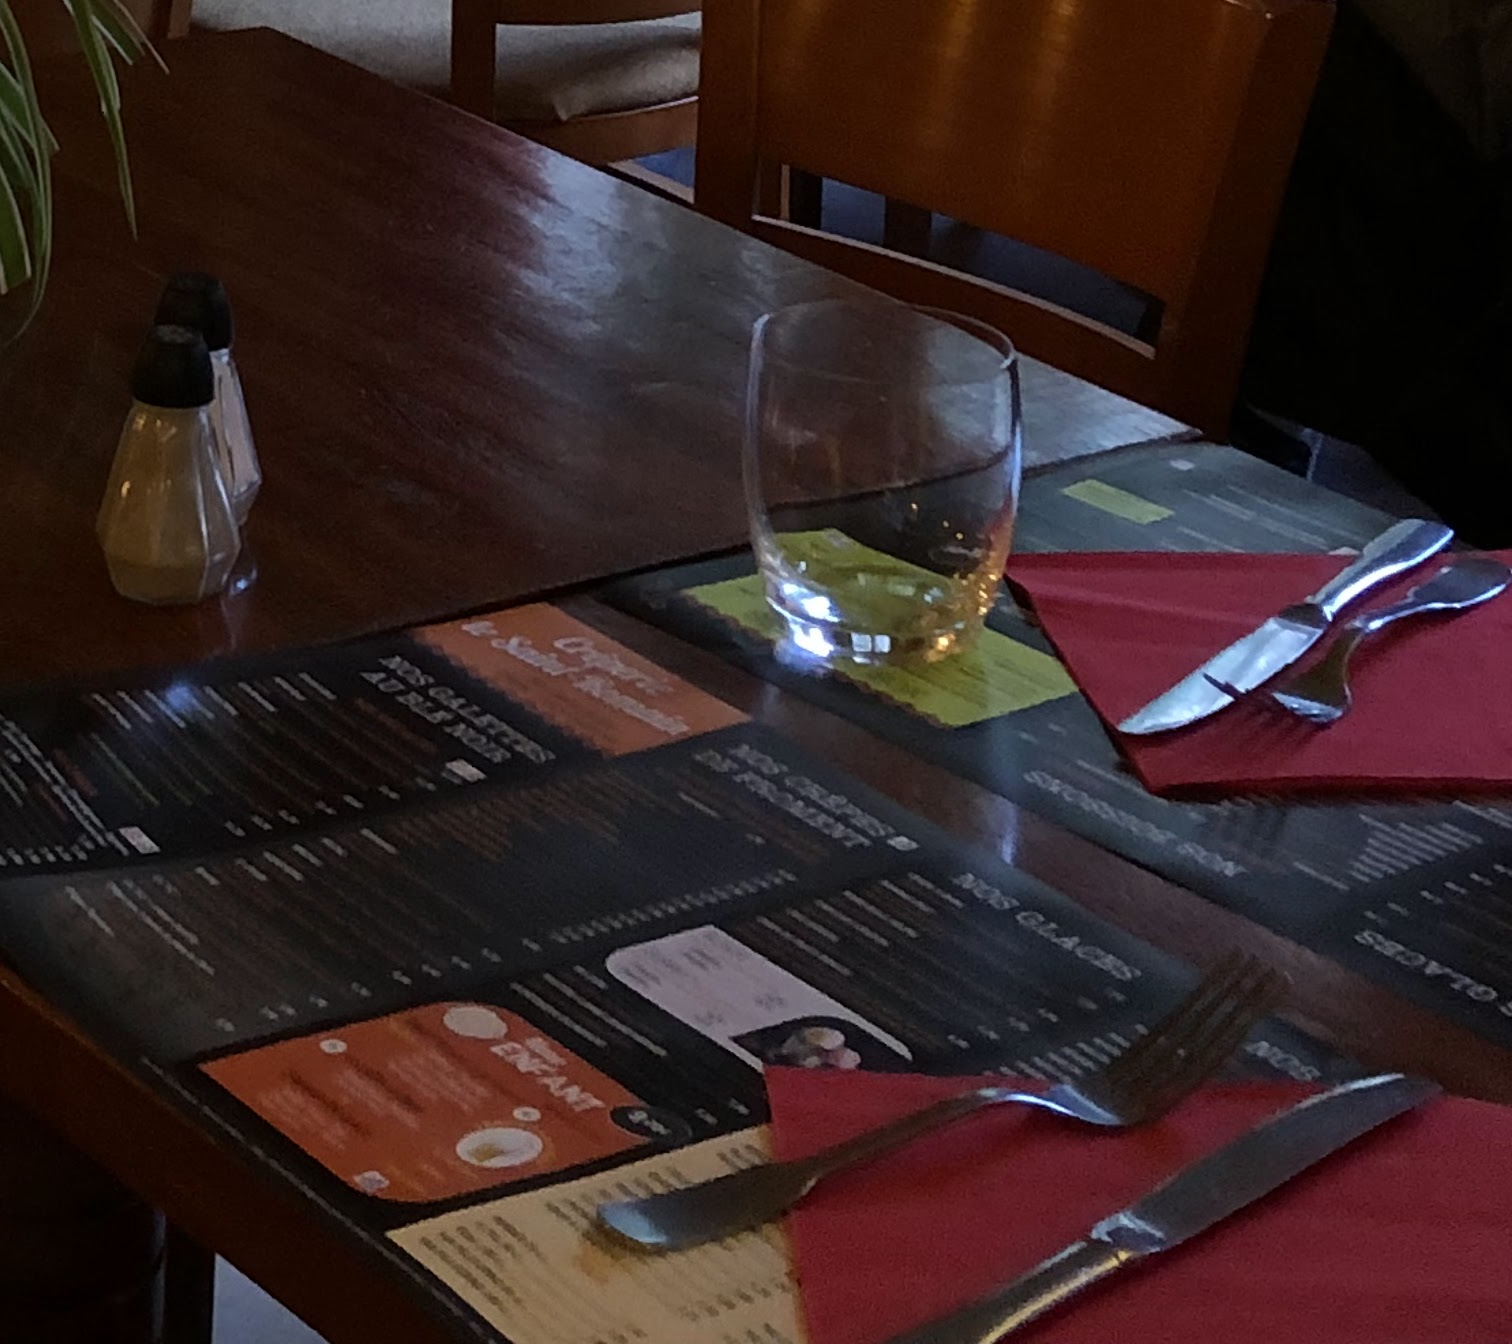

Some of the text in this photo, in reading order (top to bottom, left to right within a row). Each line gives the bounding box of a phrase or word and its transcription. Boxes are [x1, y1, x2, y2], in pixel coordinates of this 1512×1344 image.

[378, 654, 436, 688] NOS
[1014, 911, 1142, 981] GLACES
[489, 1041, 606, 1112] ENFANT
